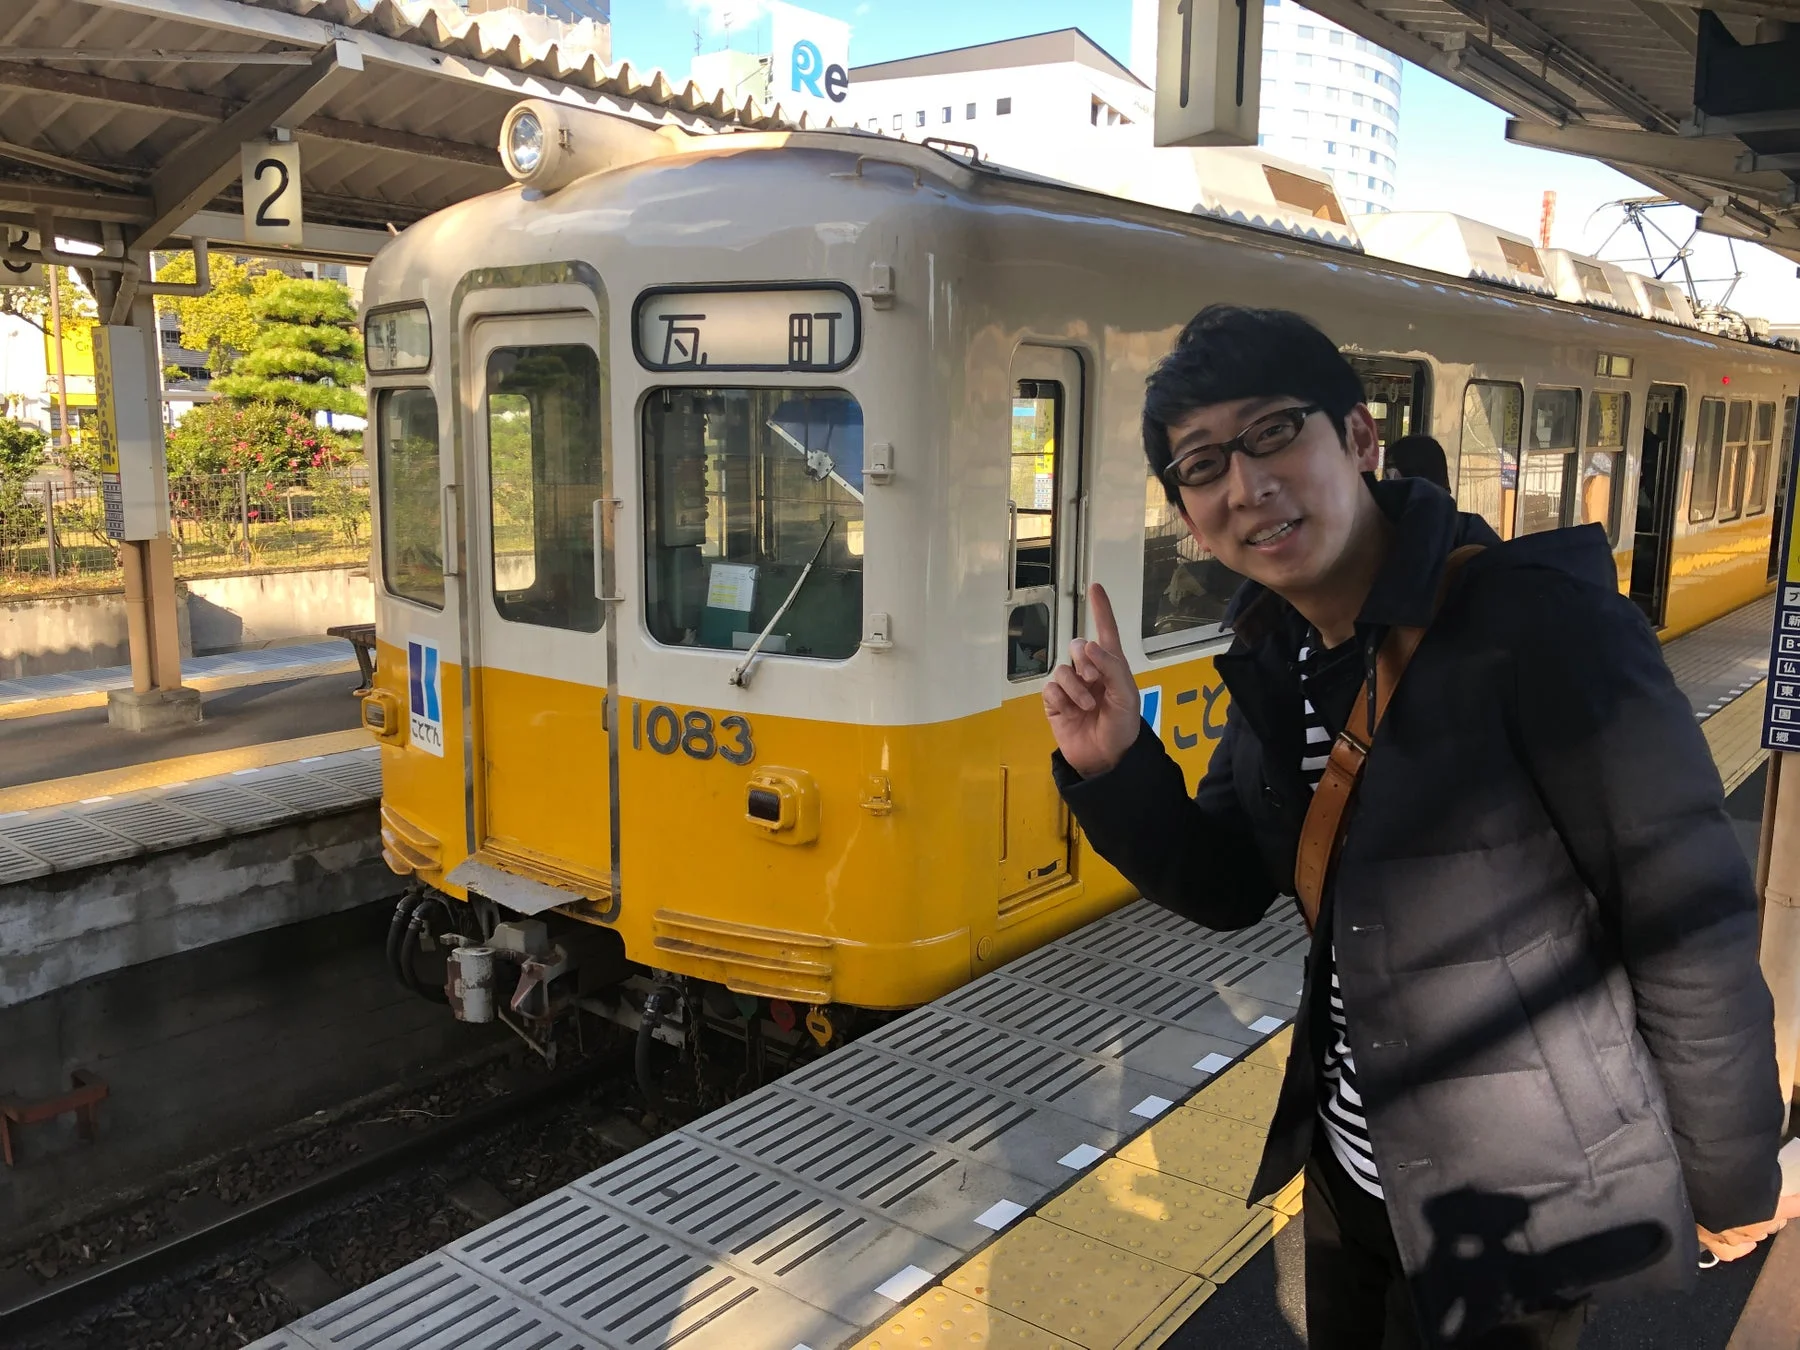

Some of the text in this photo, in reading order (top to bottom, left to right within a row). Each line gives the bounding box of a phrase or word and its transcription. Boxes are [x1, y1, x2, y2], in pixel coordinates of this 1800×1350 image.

[791, 39, 849, 103] Re
[254, 158, 290, 227] 2
[412, 718, 441, 748] ことでん
[632, 701, 756, 766] 1083
